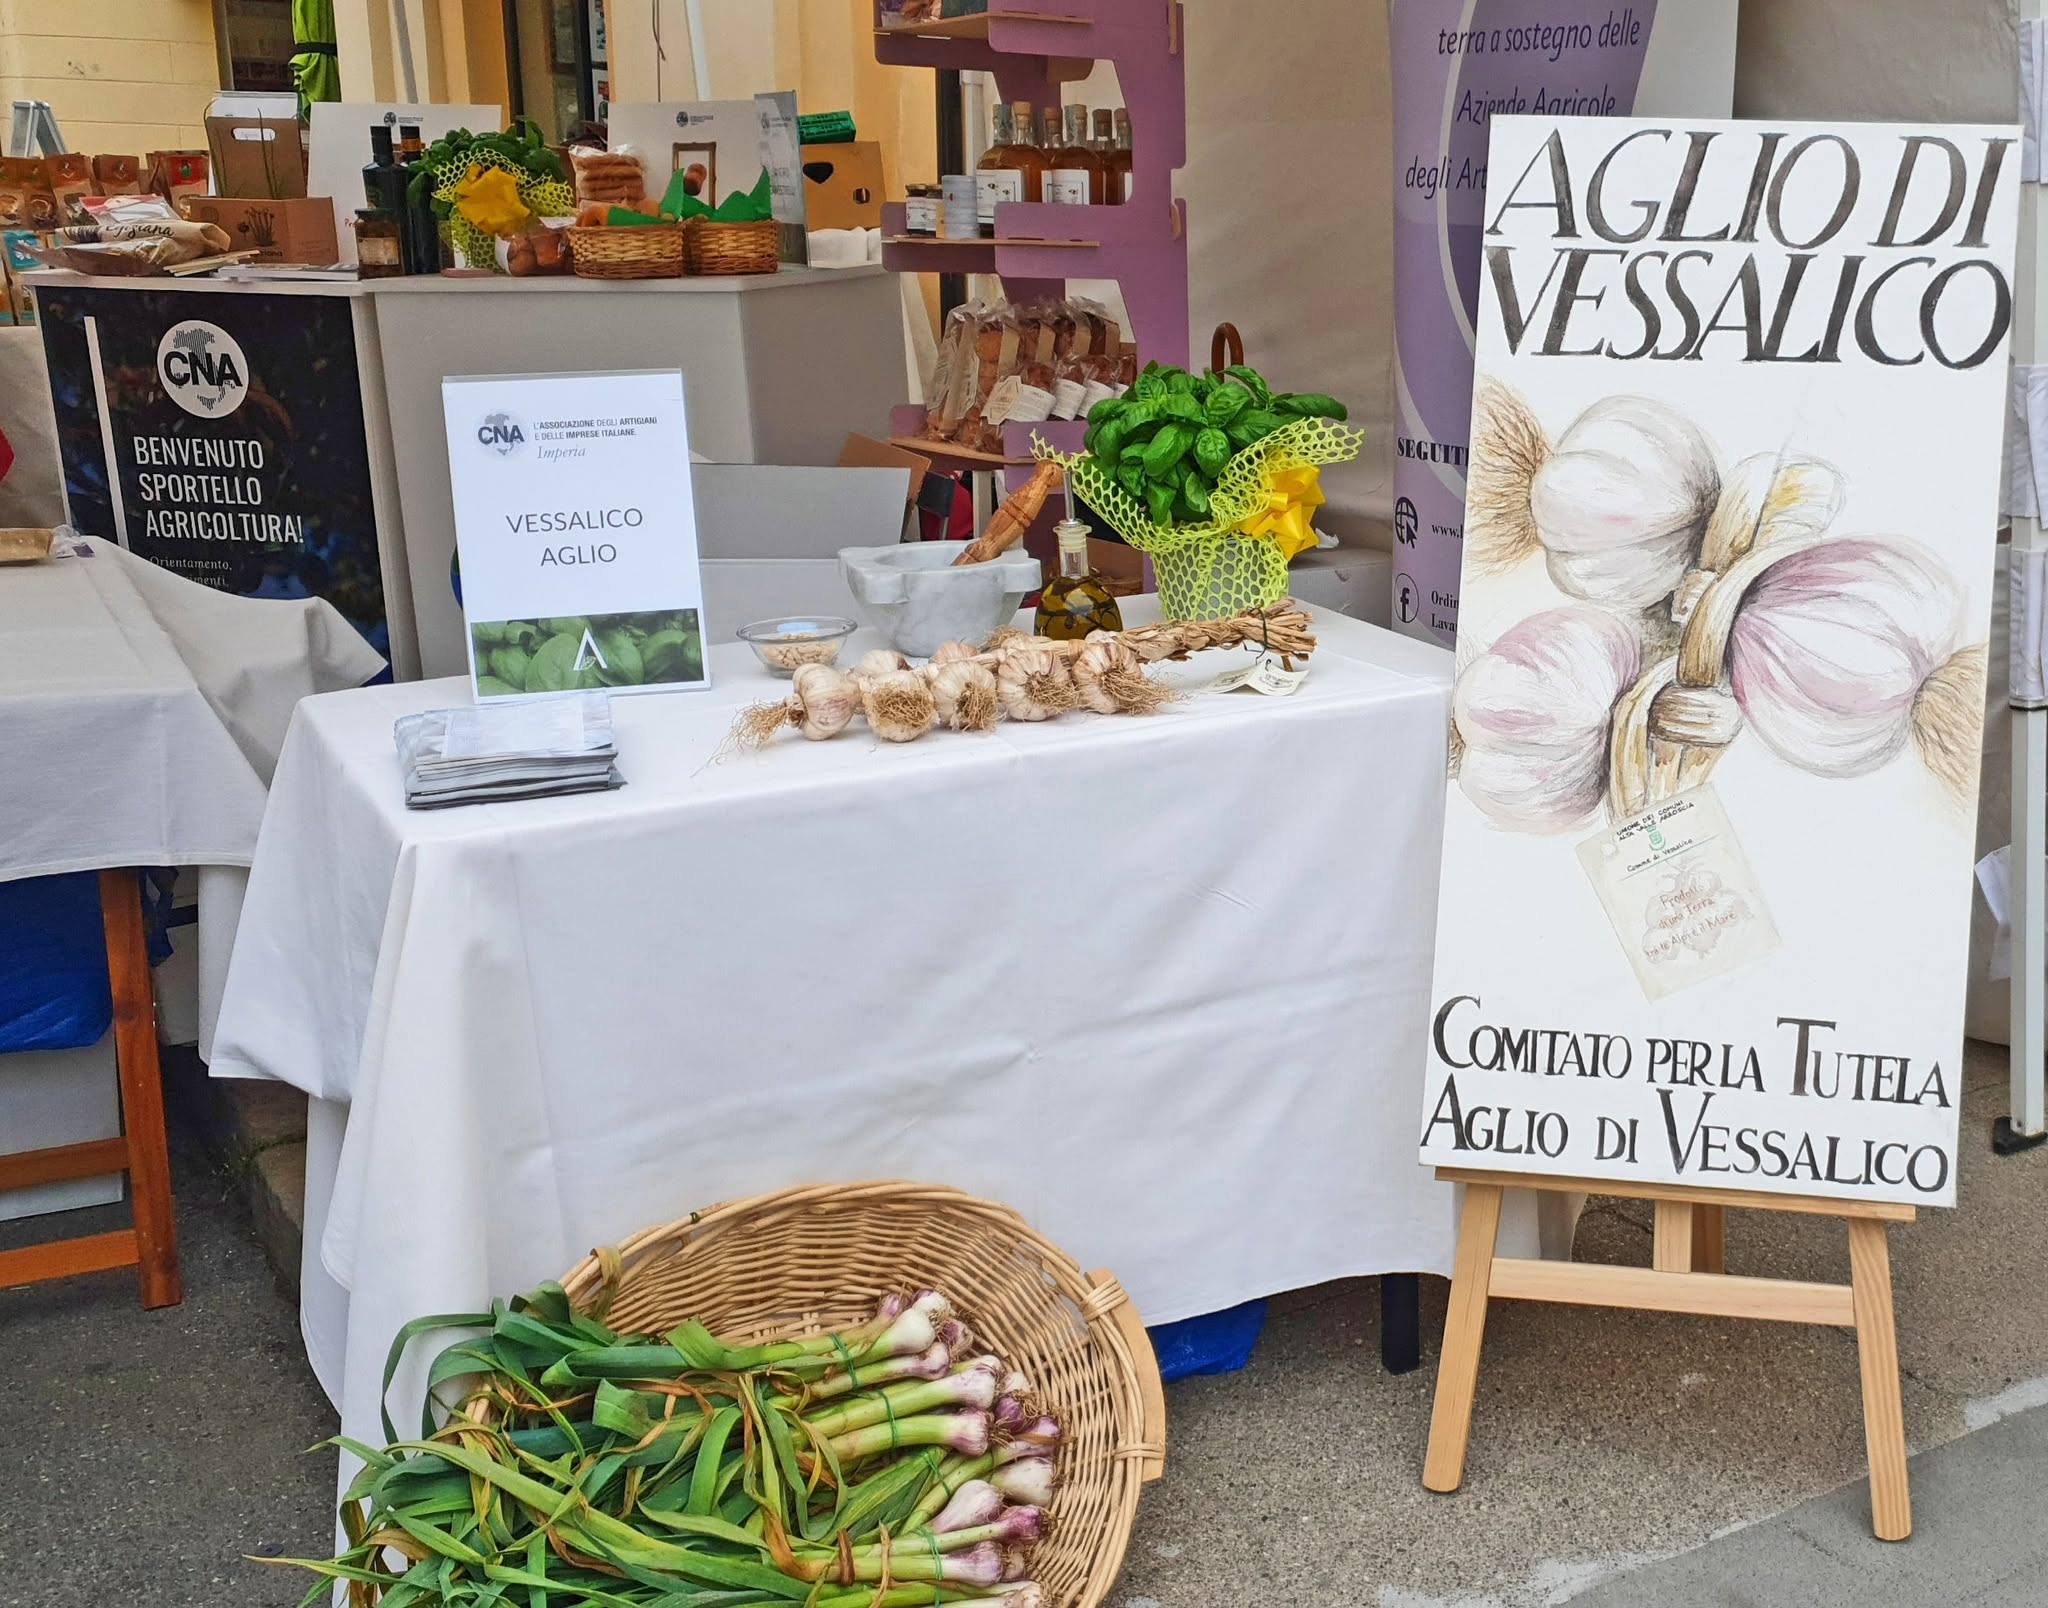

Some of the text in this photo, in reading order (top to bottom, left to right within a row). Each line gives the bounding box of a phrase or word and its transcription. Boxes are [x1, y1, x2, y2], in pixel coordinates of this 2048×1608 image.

[1438, 8, 1641, 62] terra a sostegno delle
[1406, 156, 1450, 200] degli
[1485, 128, 2018, 250] AGLIO DI
[1484, 244, 2012, 370] VESSALICO
[164, 350, 243, 388] CNA
[478, 424, 525, 445] CNA
[533, 416, 658, 431] L'ASSOCIAZIONE DEGLI ARTIGIANI
[534, 428, 636, 441] E DELLE IMPRESE ITALIANE
[133, 436, 264, 469] BENVENUTO
[537, 444, 587, 463] Imperia
[139, 473, 262, 505] SPORTELLO
[146, 509, 304, 544] AGRICOLTURA!
[505, 507, 643, 534] VESSALICO
[540, 544, 617, 567] AGLIO
[1658, 800, 1684, 816] COMUNI
[1683, 898, 1716, 915] Terra
[1707, 911, 1737, 929] Mare
[1432, 995, 1633, 1079] COMITATO
[1776, 1017, 1952, 1109] TUTELA
[1419, 1072, 1949, 1193] AGLIO DI VESSALICO
